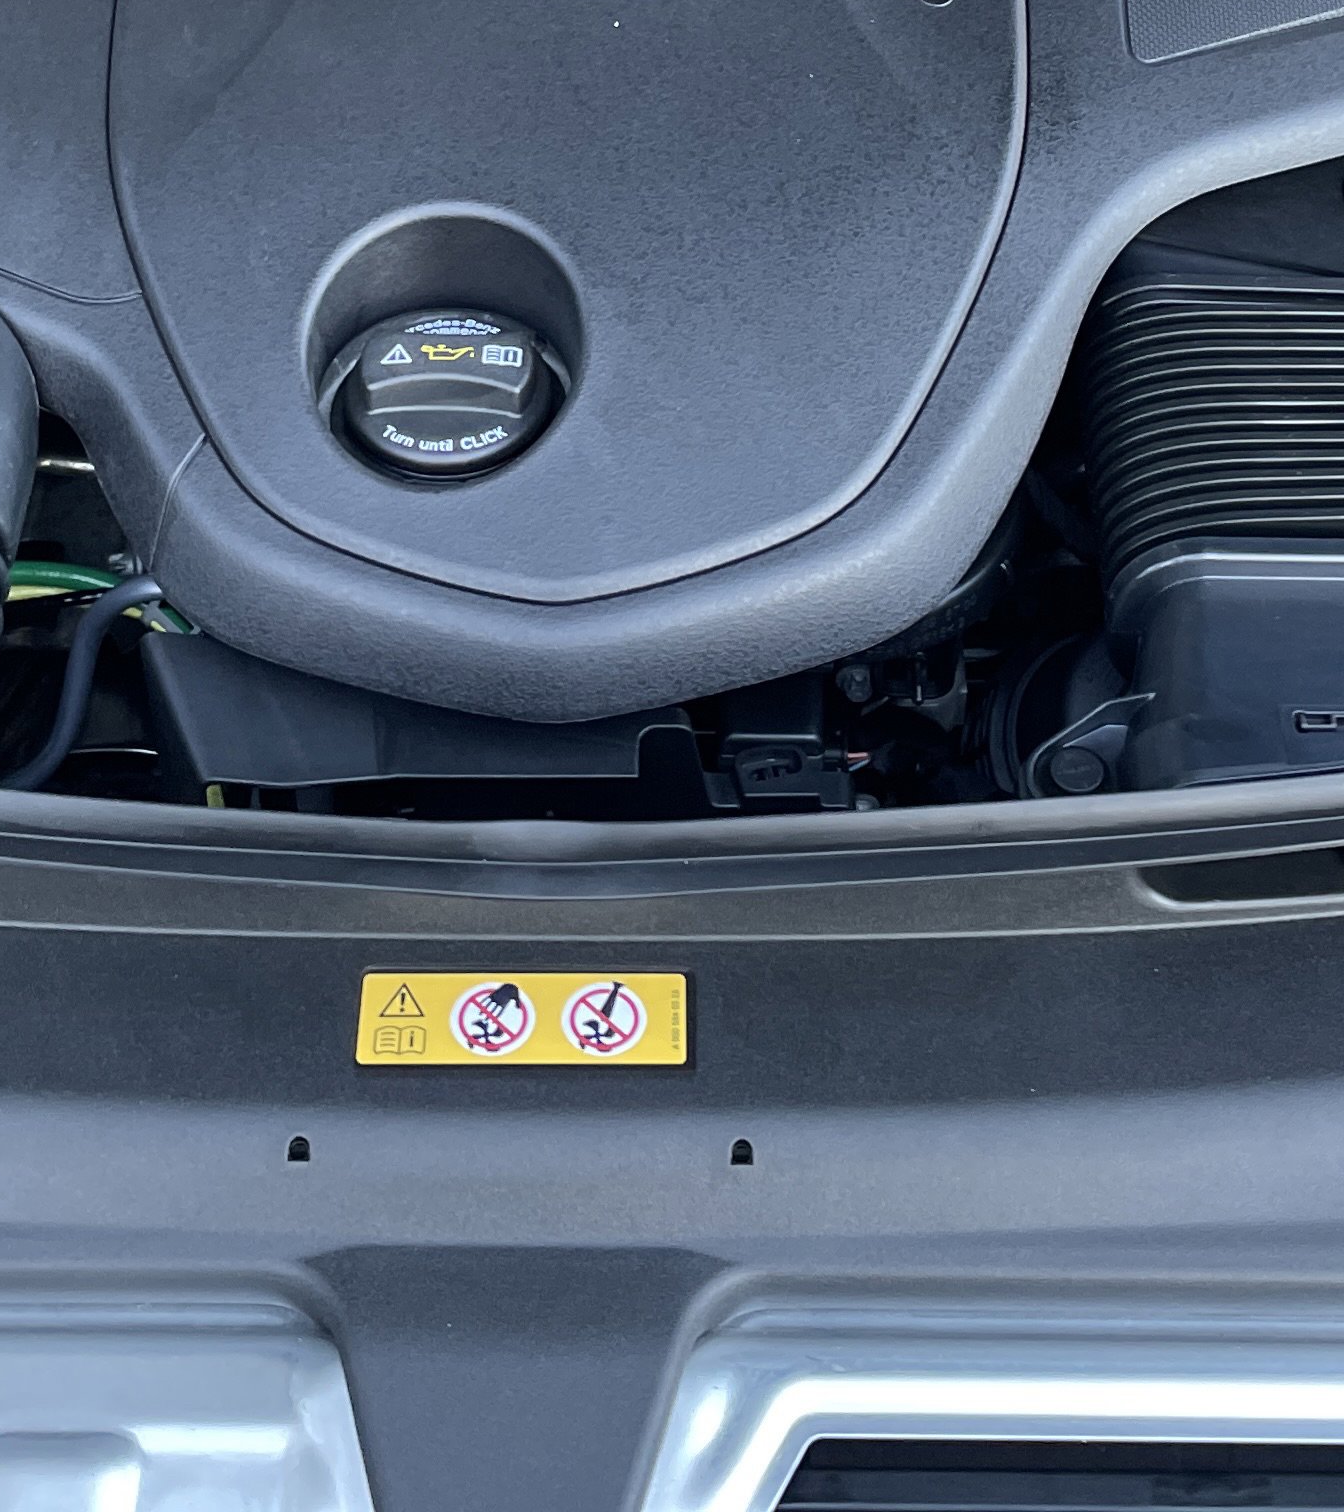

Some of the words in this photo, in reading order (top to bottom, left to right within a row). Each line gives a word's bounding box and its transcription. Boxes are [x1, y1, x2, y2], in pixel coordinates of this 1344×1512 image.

[382, 424, 415, 448] Turn
[418, 438, 453, 452] until
[459, 425, 508, 451] CLICK
